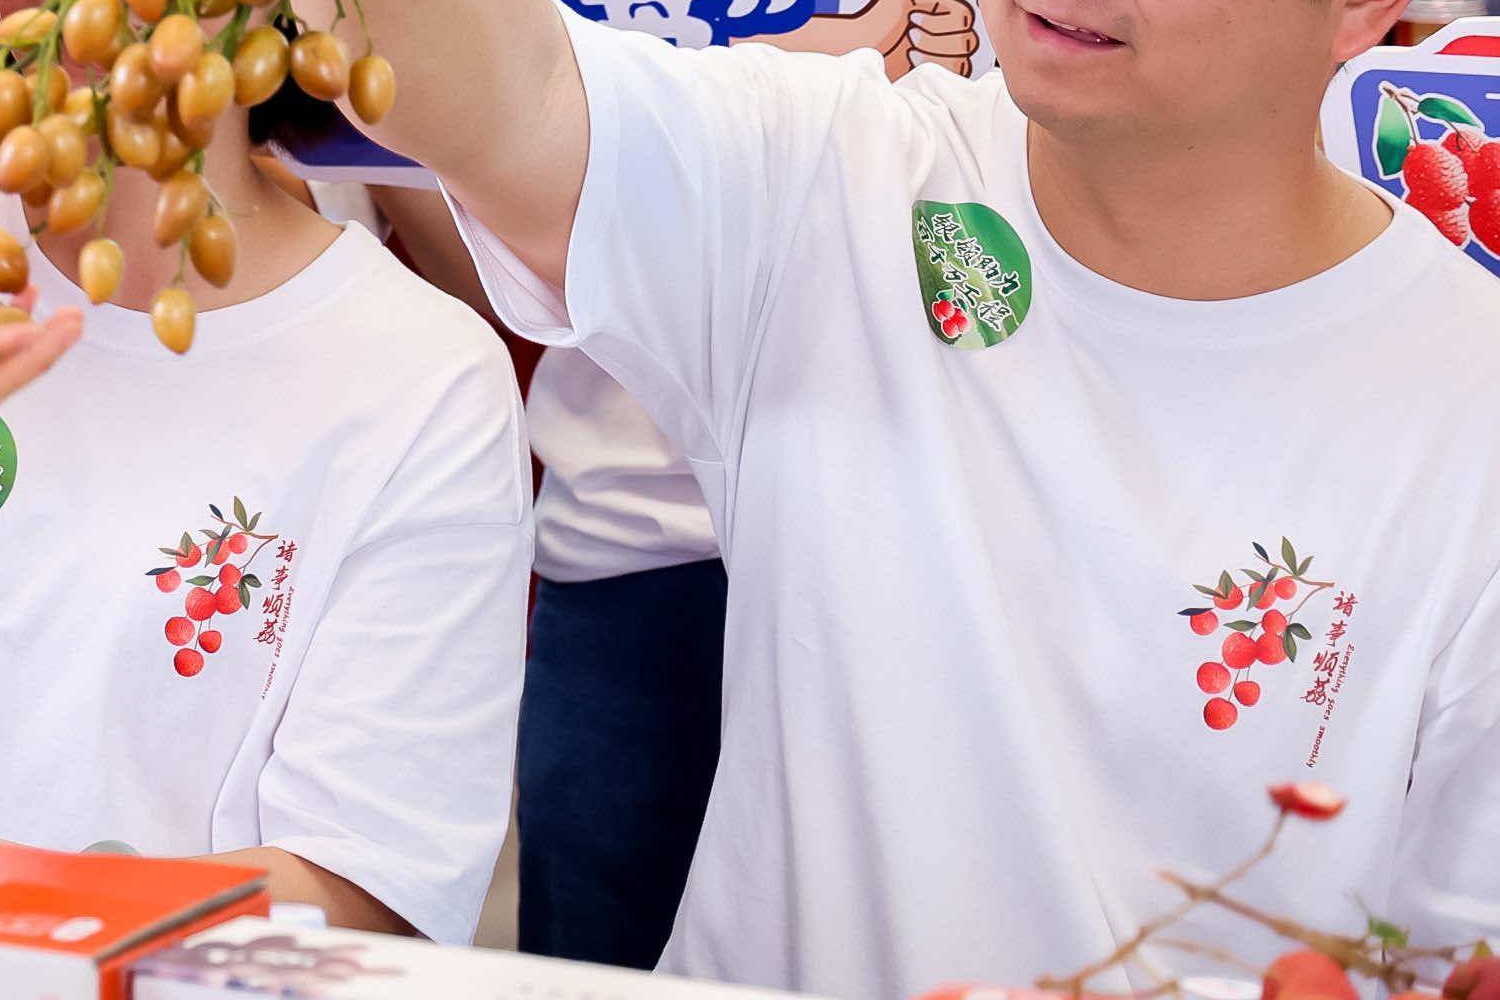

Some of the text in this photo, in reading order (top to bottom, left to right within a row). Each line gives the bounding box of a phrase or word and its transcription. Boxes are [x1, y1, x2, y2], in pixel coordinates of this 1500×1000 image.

[917, 217, 1012, 331] 百千万工程
[1323, 698, 1336, 721] goes
[1306, 726, 1326, 768] smoothly
